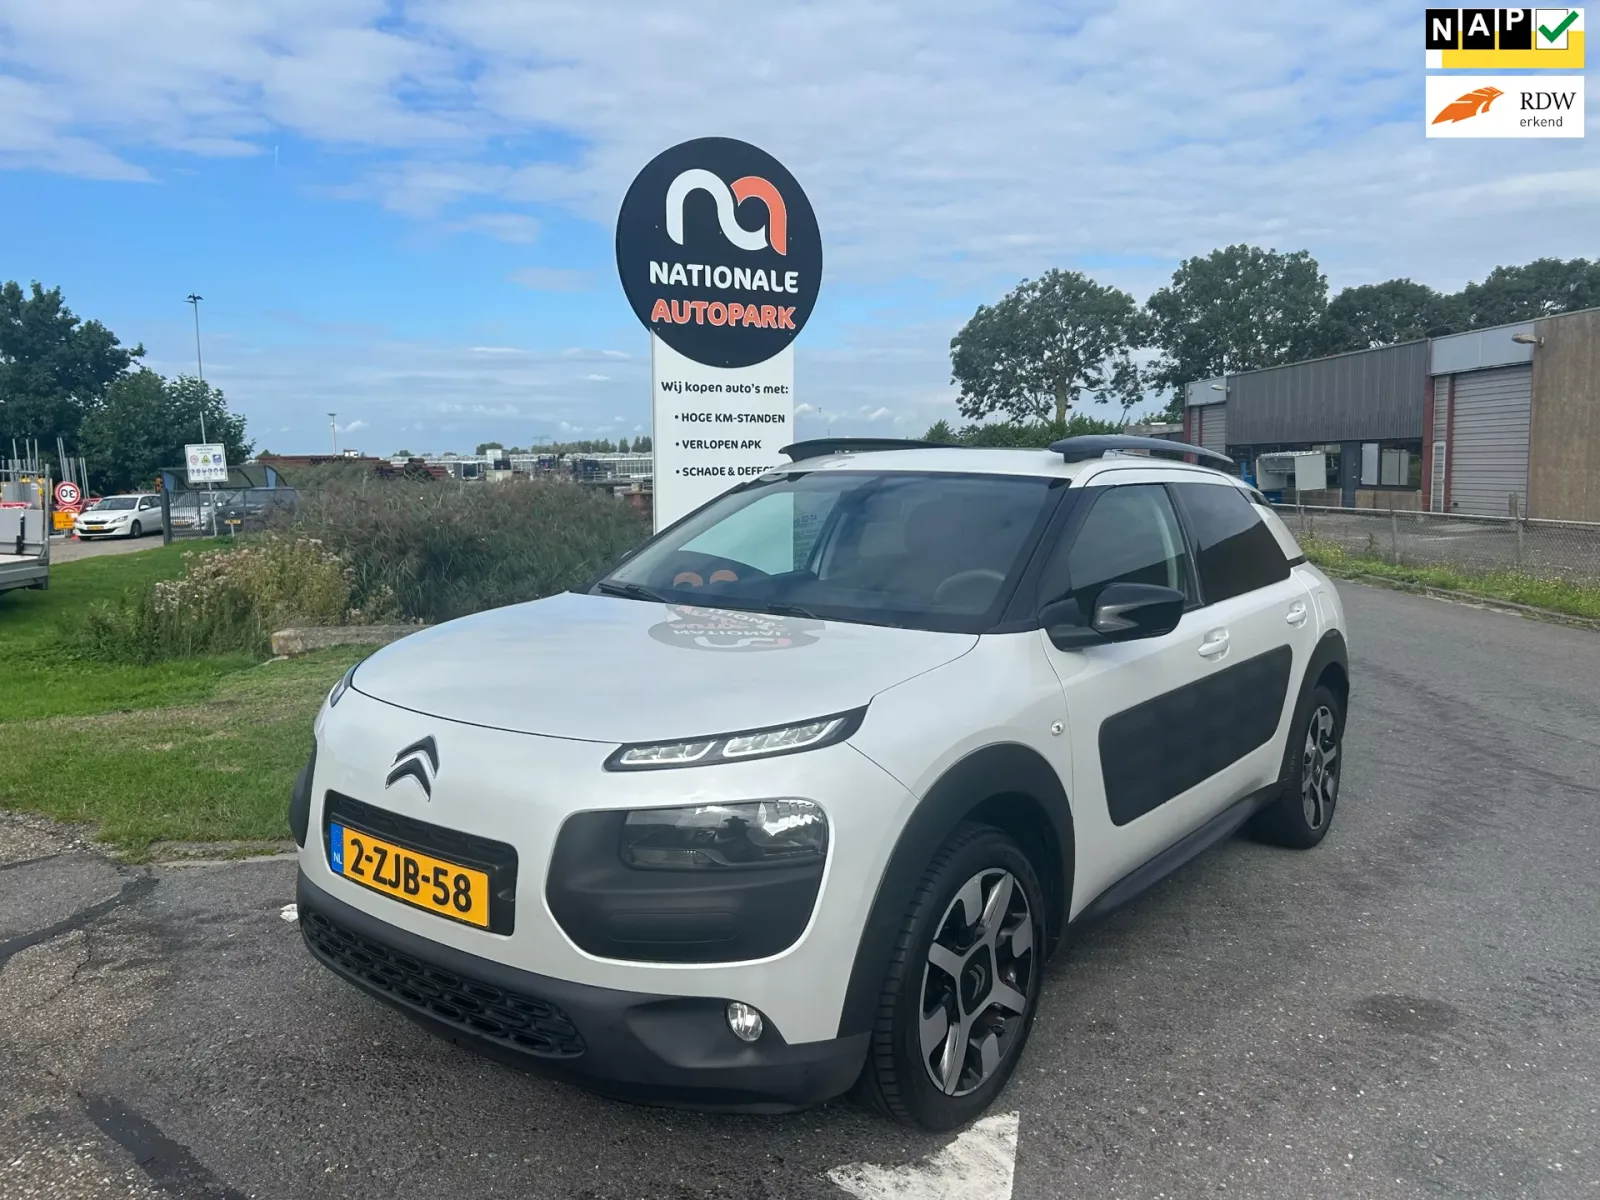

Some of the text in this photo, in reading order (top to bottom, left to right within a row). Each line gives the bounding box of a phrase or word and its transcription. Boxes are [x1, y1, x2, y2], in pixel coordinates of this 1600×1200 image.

[649, 260, 799, 294] NATIONALE
[651, 298, 796, 330] AUTOPARK
[661, 381, 789, 394] Wij kopen auto's met:
[681, 412, 785, 423] HOGE KM-STANDEN
[682, 440, 762, 449] VERLOPEN APK
[682, 466, 726, 476] SCHADE
[727, 466, 736, 476] &
[333, 851, 343, 865] NL
[350, 837, 472, 913] 2-ZJB-58
